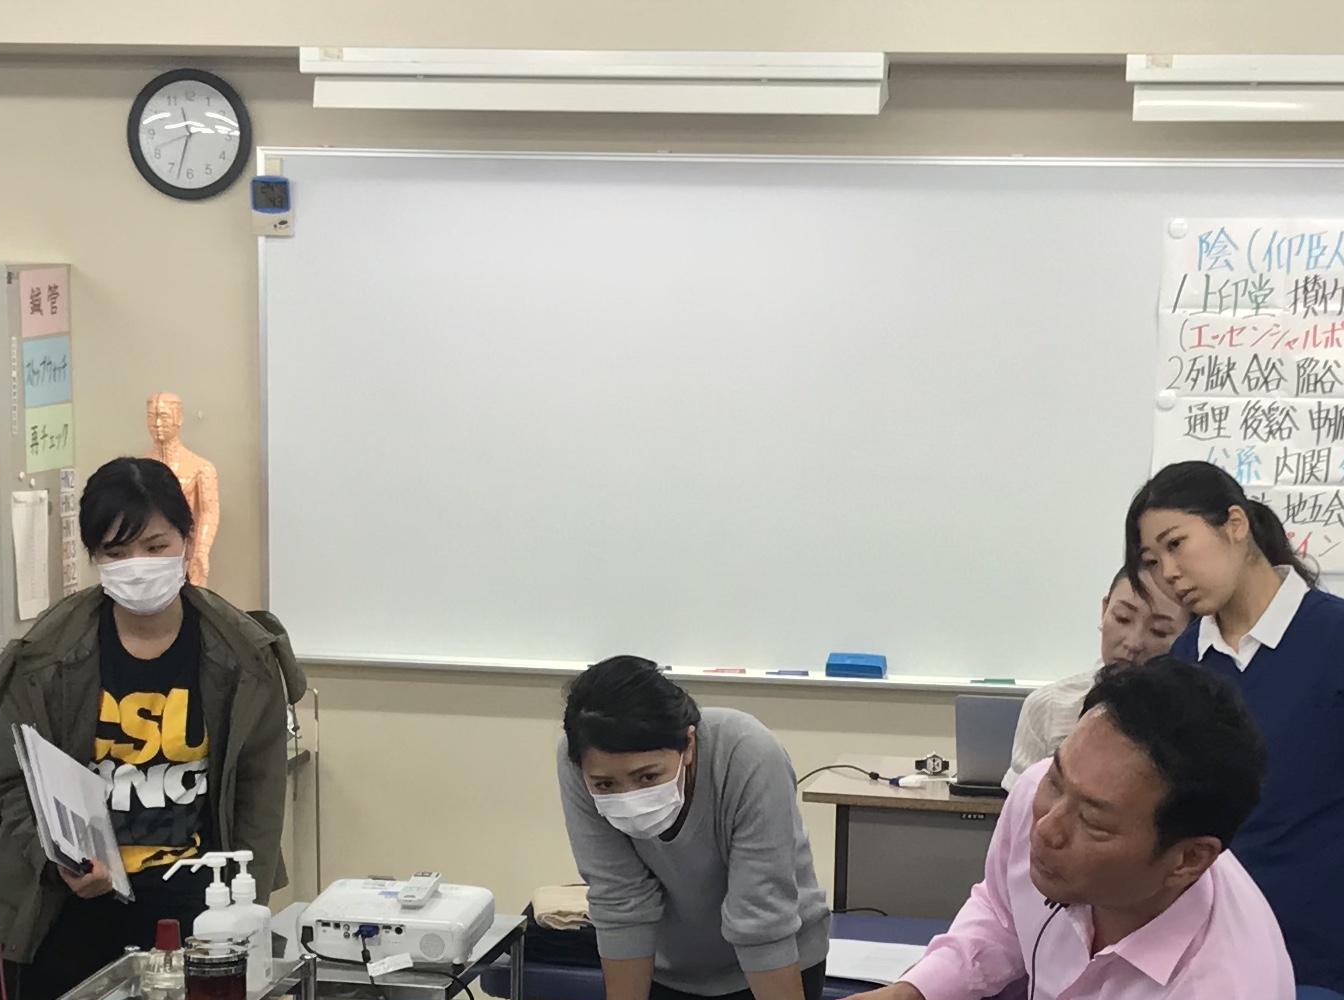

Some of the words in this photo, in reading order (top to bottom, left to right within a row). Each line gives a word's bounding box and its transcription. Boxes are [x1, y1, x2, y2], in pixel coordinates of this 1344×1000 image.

[167, 96, 178, 107] 11
[185, 89, 196, 101] 12
[1242, 353, 1289, 394] 合谷
[1183, 401, 1232, 441] 通里
[1274, 446, 1332, 486] 内関
